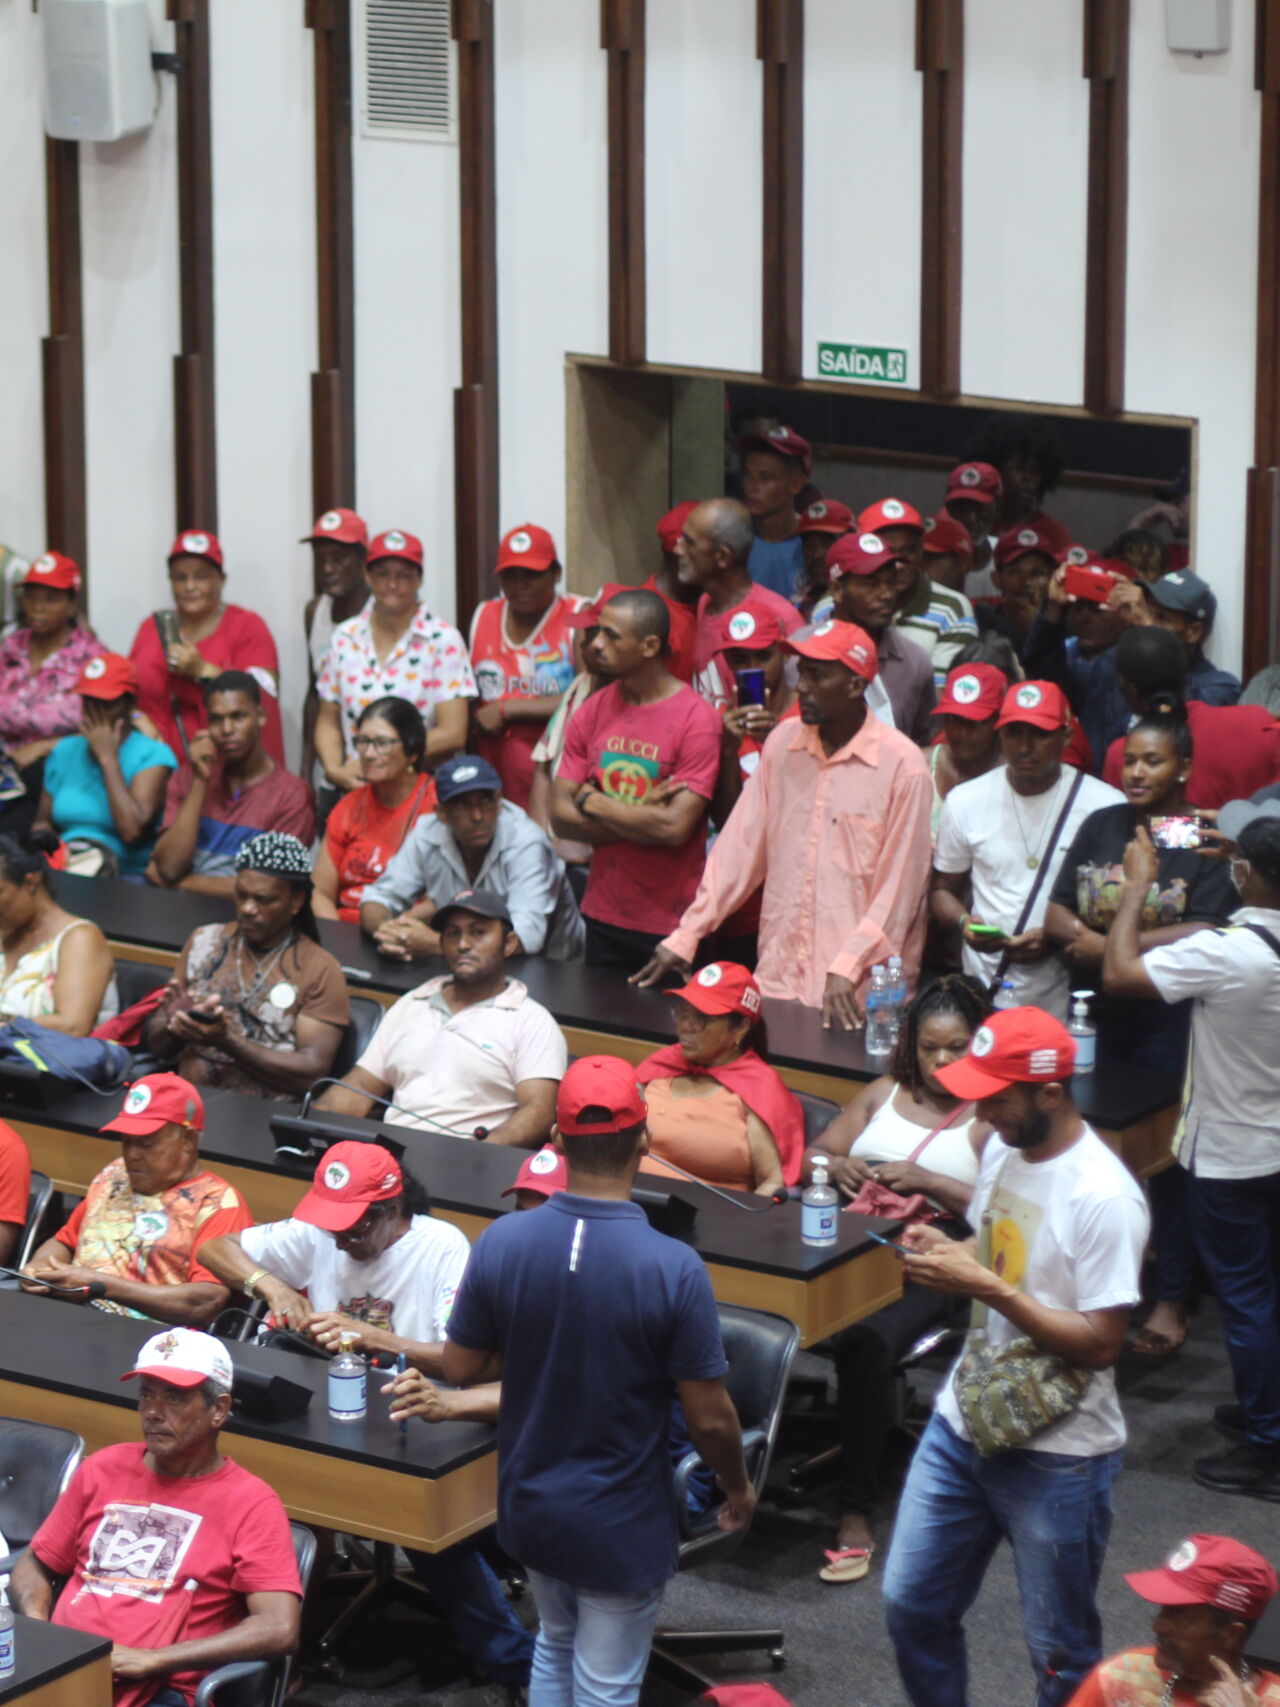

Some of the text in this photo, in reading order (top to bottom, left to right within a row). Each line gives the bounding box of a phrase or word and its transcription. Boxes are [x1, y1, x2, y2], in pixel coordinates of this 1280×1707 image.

[820, 347, 885, 376] SAÍDA
[508, 676, 560, 695] FOLIA
[607, 735, 659, 761] GUCCI
